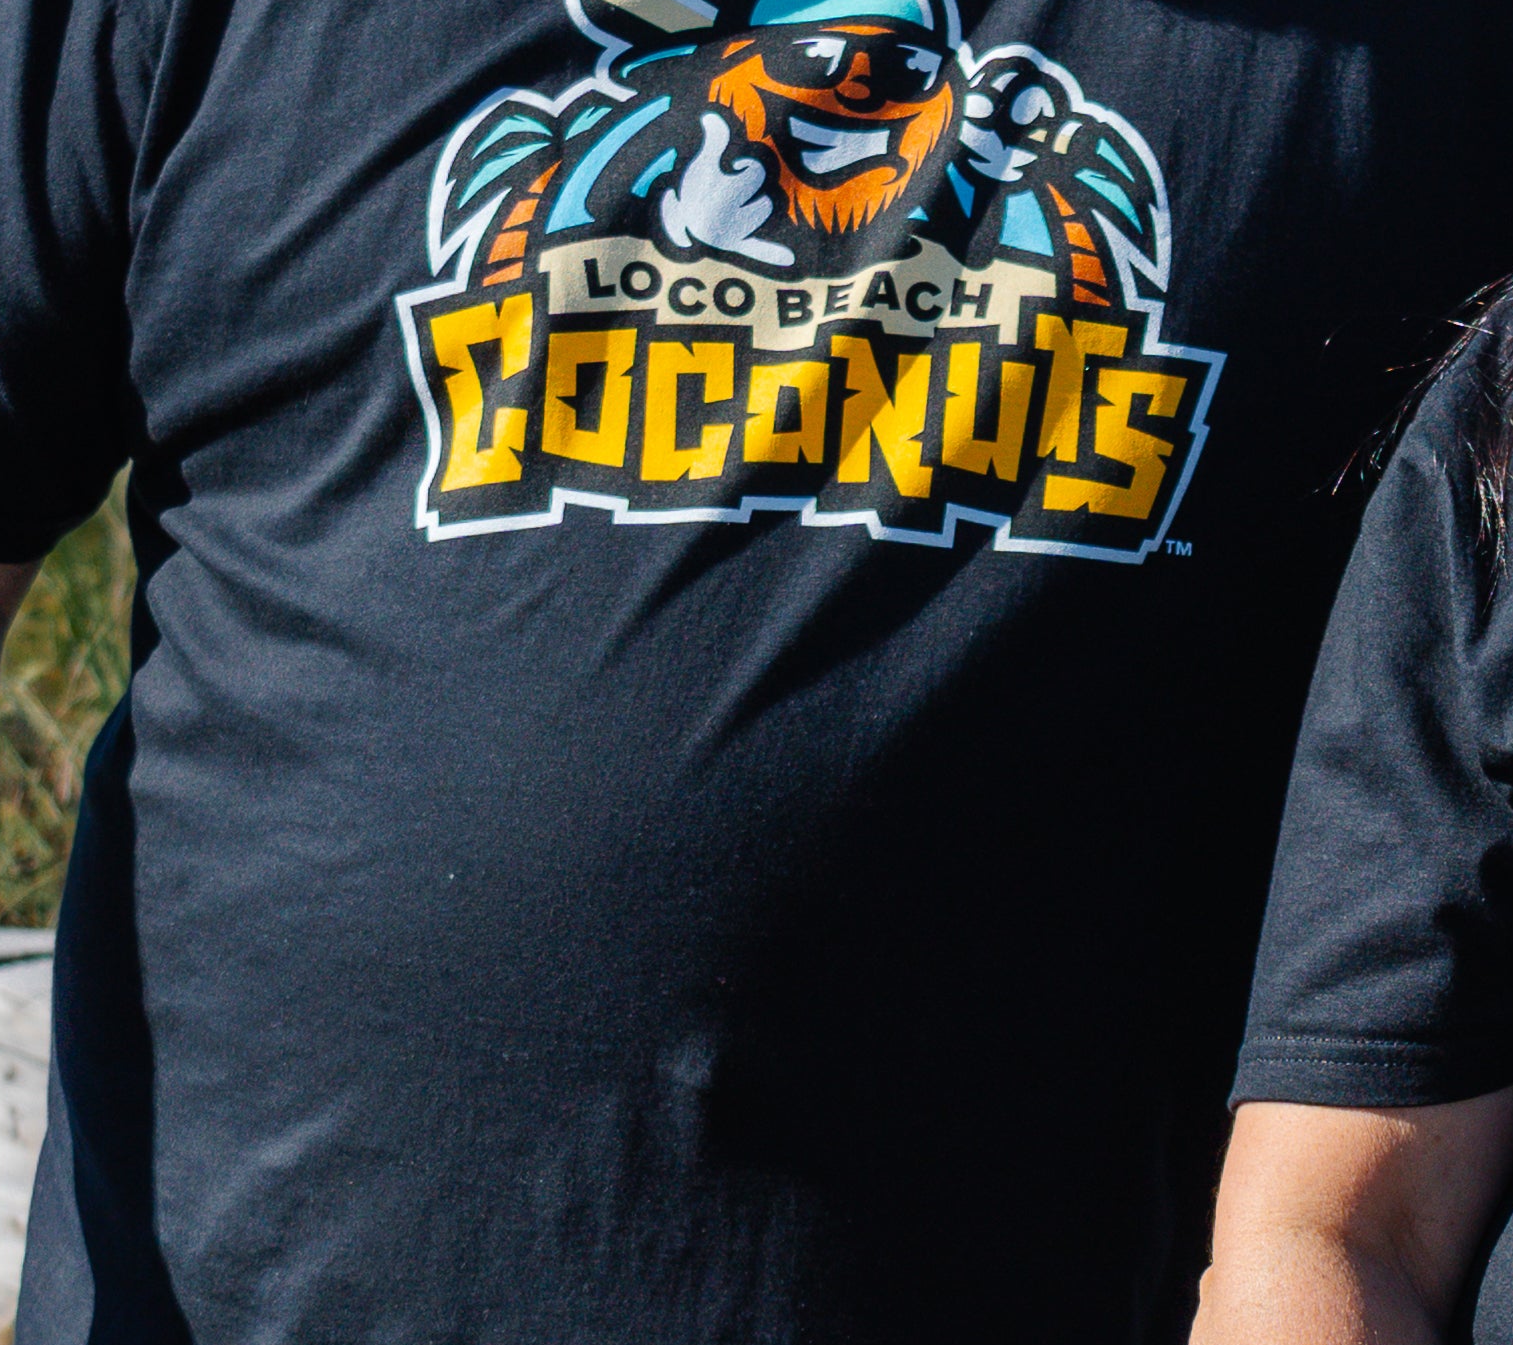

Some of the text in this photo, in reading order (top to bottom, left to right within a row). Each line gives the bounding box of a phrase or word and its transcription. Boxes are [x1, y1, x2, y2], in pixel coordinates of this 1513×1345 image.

[583, 257, 993, 328] LOCO BEACH
[430, 292, 1188, 520] COCONUTS
[1165, 538, 1193, 557] TM
